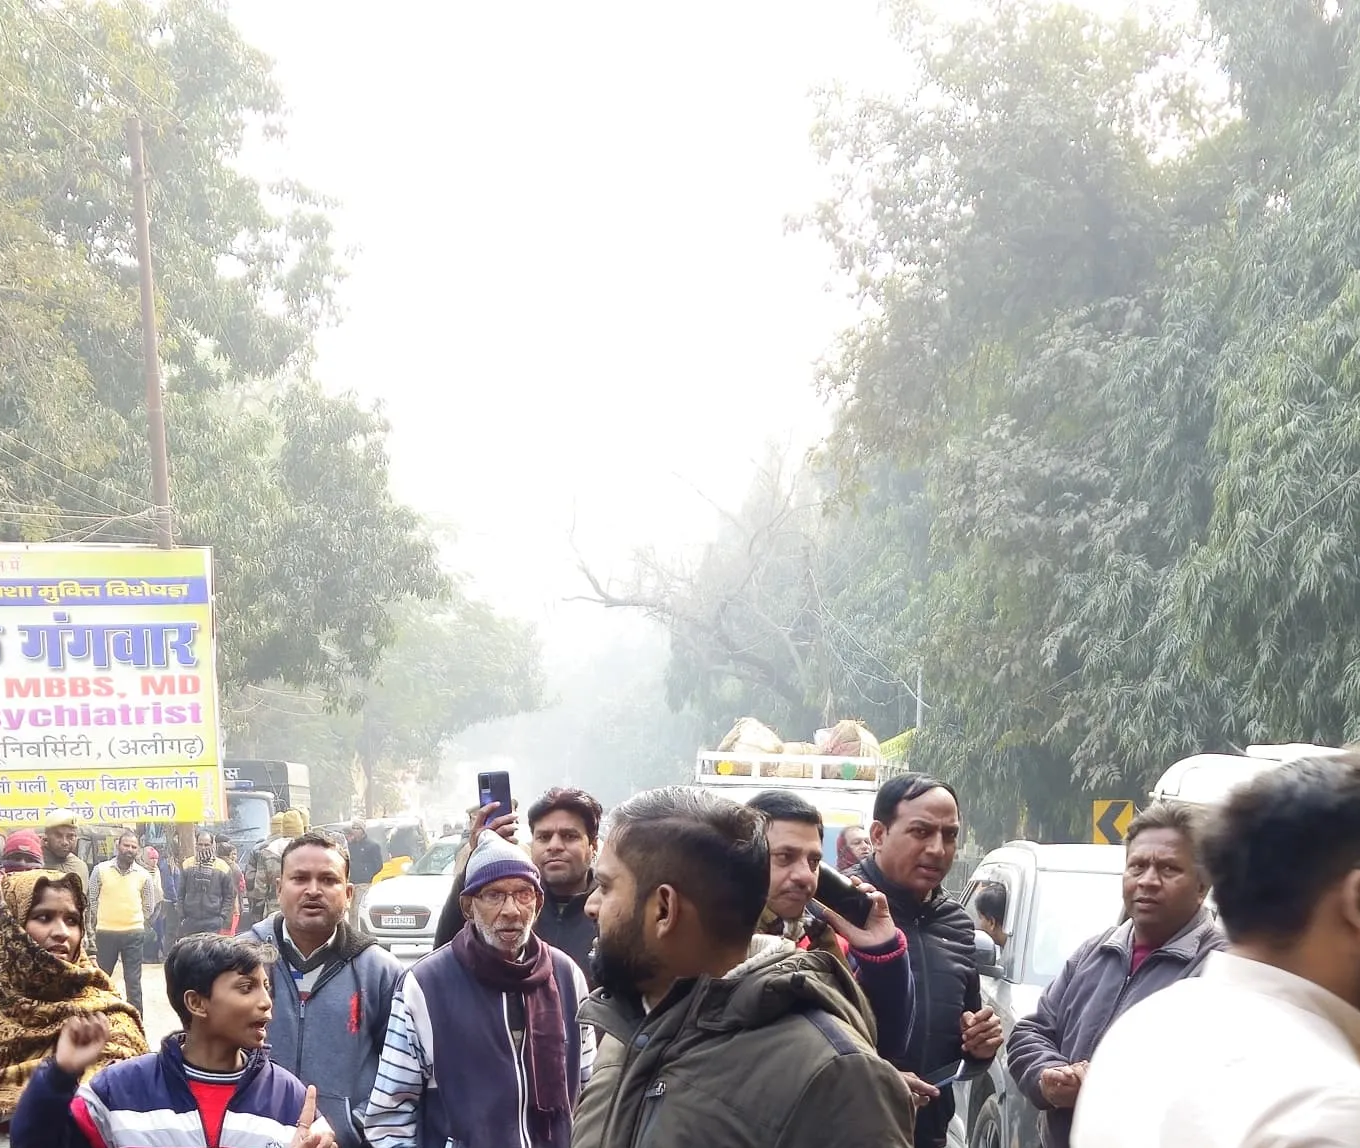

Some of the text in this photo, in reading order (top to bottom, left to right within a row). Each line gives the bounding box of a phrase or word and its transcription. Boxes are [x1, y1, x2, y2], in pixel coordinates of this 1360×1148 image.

[16, 610, 200, 669] गंगवार
[139, 674, 201, 696] MD
[107, 732, 206, 760] (अलीगढ़)
[59, 778, 96, 797] कृष्ण
[100, 773, 138, 792] विहार
[98, 801, 176, 822] (पीलीभीत)
